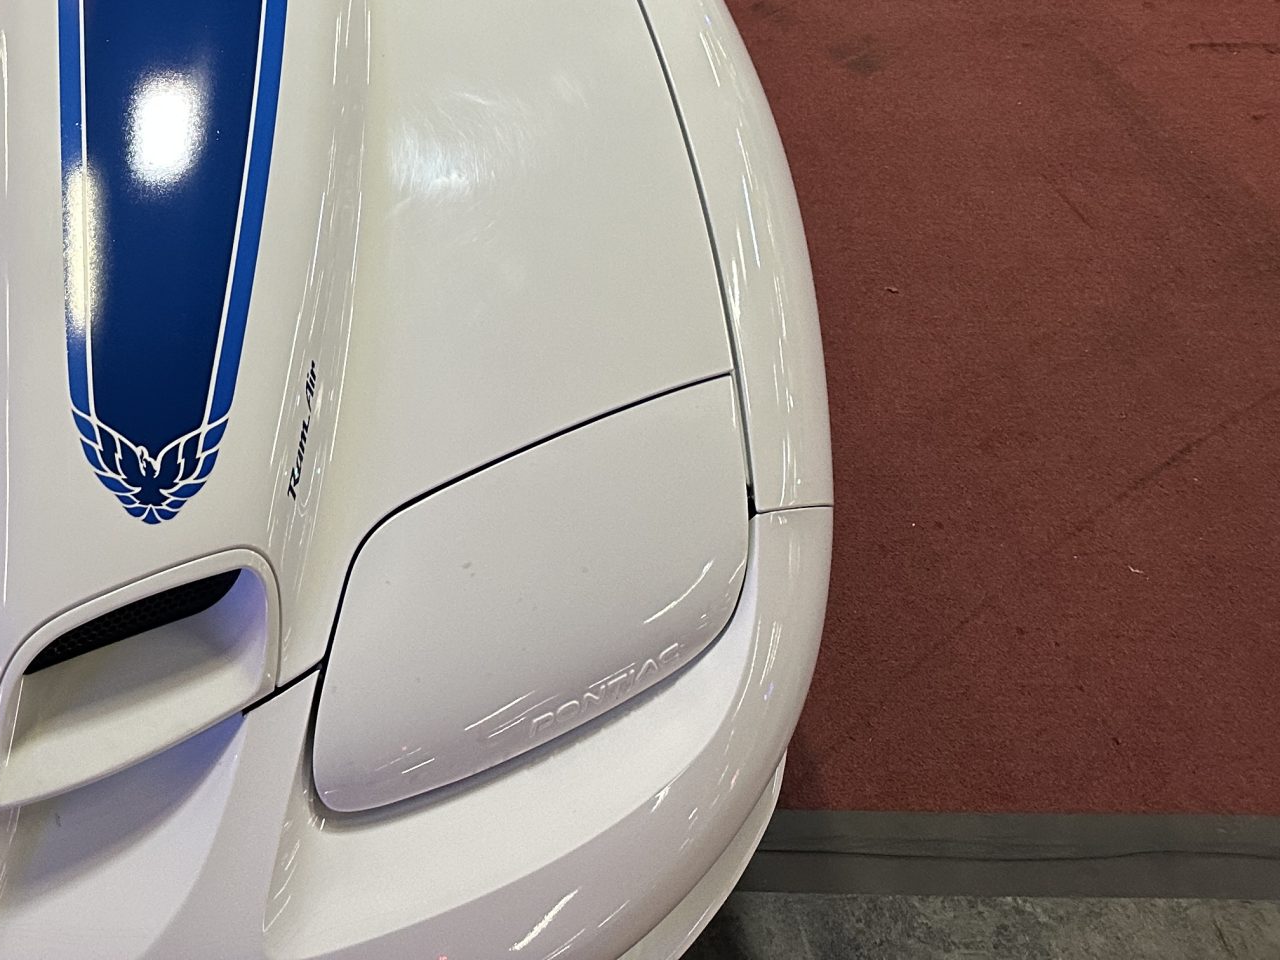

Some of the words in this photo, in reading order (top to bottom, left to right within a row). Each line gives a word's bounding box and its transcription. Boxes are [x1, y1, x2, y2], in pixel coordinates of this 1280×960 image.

[287, 415, 311, 501] Ram
[305, 359, 317, 413] Air
[528, 642, 681, 738] PONTIAC
